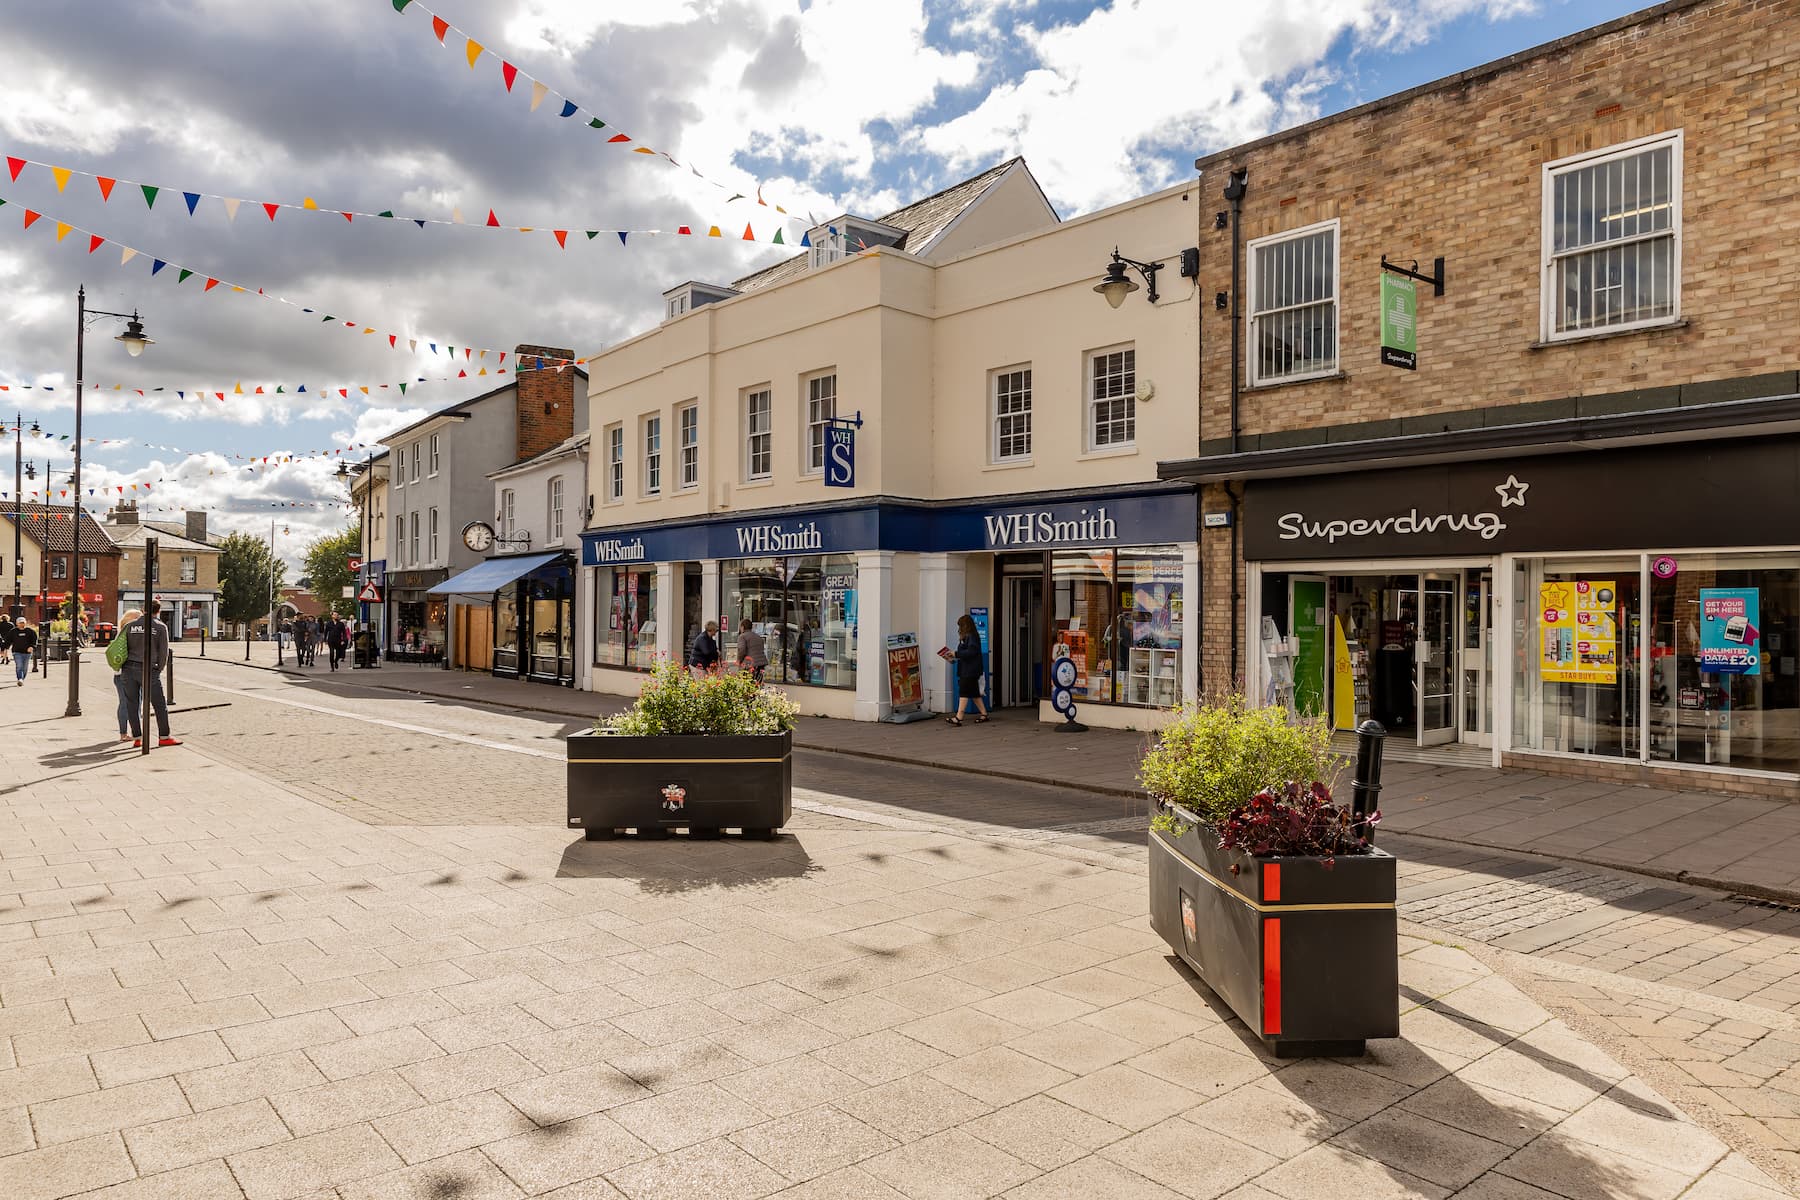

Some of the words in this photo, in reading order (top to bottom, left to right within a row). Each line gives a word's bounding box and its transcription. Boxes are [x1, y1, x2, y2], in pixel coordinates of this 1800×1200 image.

[1386, 276, 1414, 292] PHARMACY
[1386, 352, 1413, 366] Superdrug
[831, 430, 851, 444] WH
[831, 443, 852, 484] S
[984, 507, 1118, 546] WHSmith
[1277, 508, 1507, 544] Superdrug
[736, 521, 823, 553] WHSmith
[594, 537, 645, 563] WHSmith
[1153, 566, 1183, 576] PERFE
[825, 575, 854, 587] GREAT
[822, 588, 846, 601] OFFE
[889, 647, 917, 663] NEW
[1704, 647, 1750, 655] UNLIMITED
[1704, 654, 1729, 662] DATA
[1729, 655, 1758, 666] £20
[1560, 671, 1577, 680] STAR
[1578, 672, 1597, 681] BUYS
